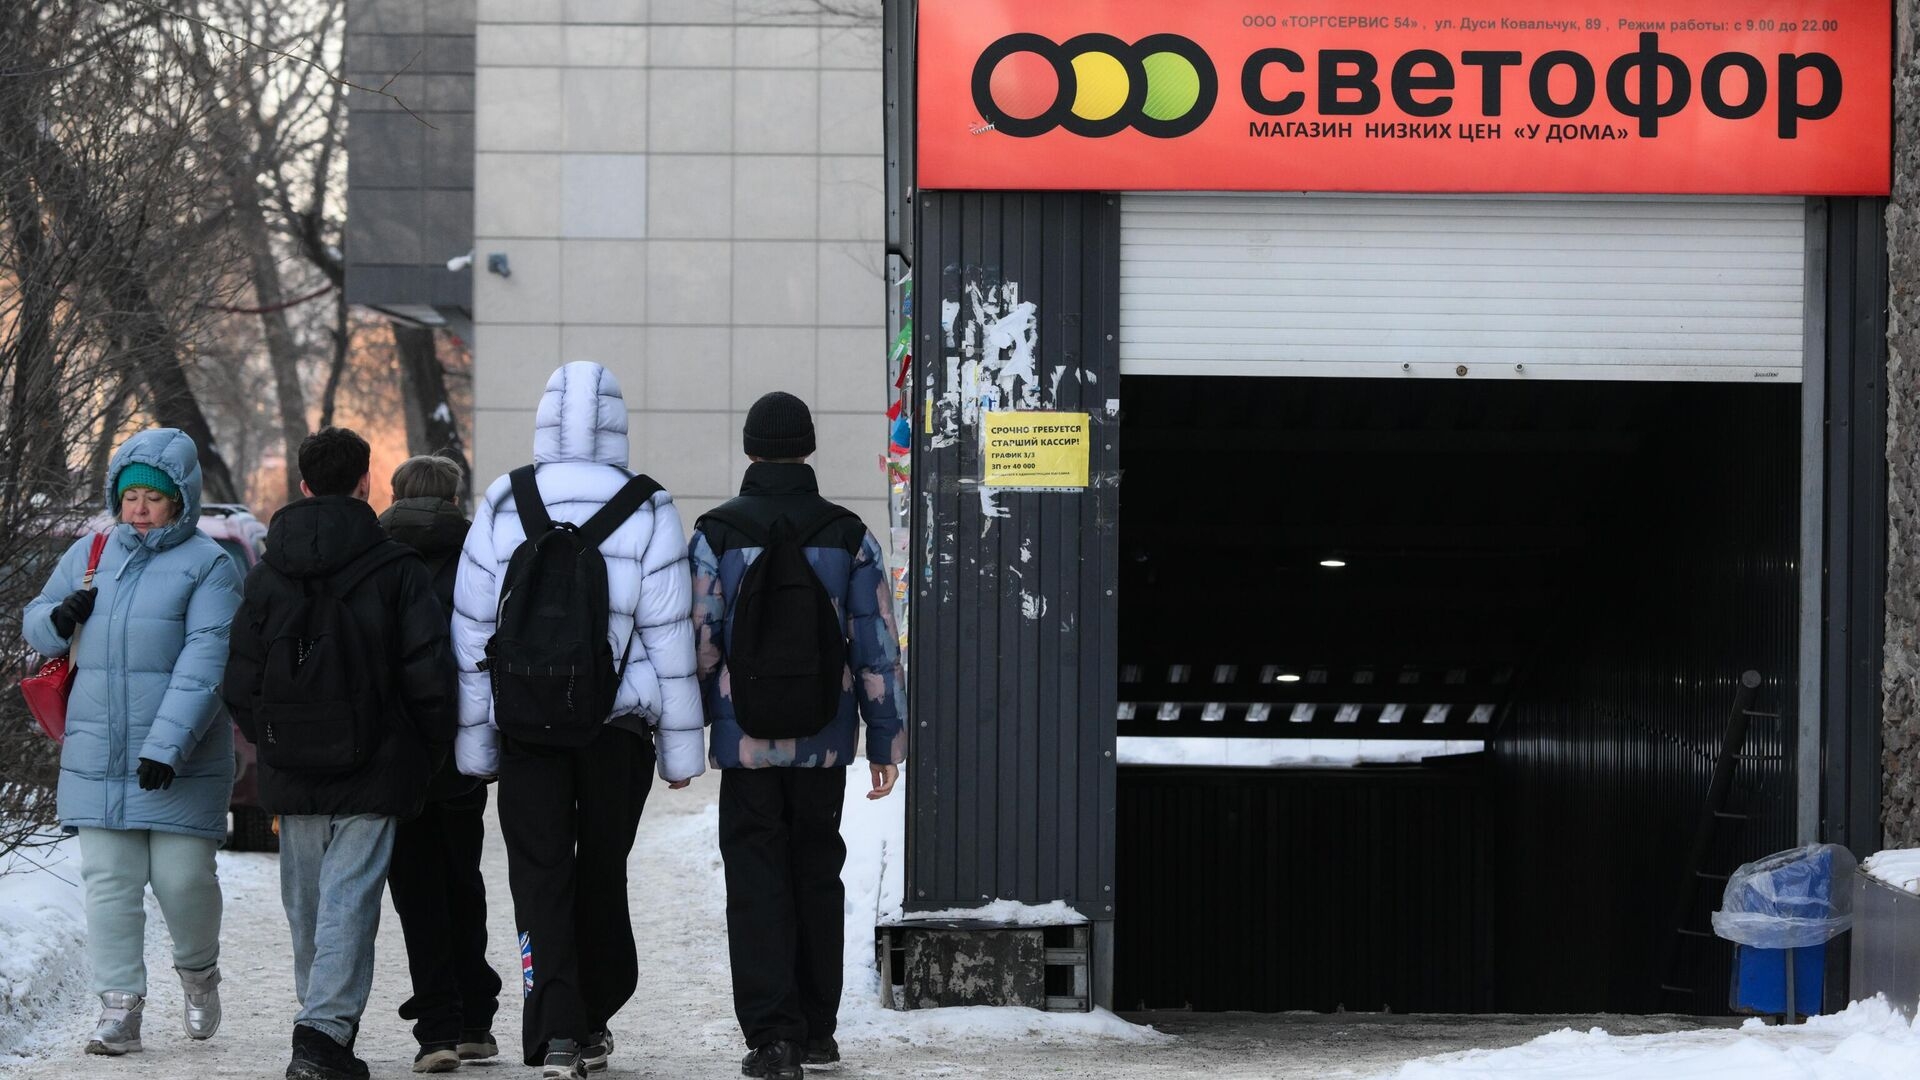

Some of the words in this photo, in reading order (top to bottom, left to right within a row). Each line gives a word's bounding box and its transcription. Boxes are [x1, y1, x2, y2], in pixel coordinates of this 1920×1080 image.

[1242, 15, 1277, 28] ООО
[1281, 15, 1389, 29] «ТОРГСЕРВИС
[1394, 17, 1418, 29] 54»
[1435, 19, 1456, 32] ул.
[1460, 18, 1496, 31] Дуси
[1501, 18, 1581, 32] Ковальчук,
[1585, 18, 1602, 31] 89
[1618, 19, 1666, 31] Режим
[1670, 20, 1729, 33] работы:
[1734, 22, 1742, 31] с
[1746, 20, 1775, 31] 9.00
[1779, 22, 1797, 32] до
[1802, 20, 1838, 32] 22.00
[1240, 32, 1843, 139] светофор
[1249, 122, 1352, 138] МАГАЗИН
[1365, 122, 1452, 139] НИЗКИХ
[1459, 123, 1501, 142] ЦЕН
[1514, 123, 1540, 140] «У
[1546, 124, 1628, 143] ДОМА»
[991, 426, 1030, 435] СРОЧНО
[1033, 425, 1081, 434] ТРЕБУЕТСЯ
[991, 437, 1038, 447] СТАРШИЙ
[1040, 438, 1080, 446] КАССИР!
